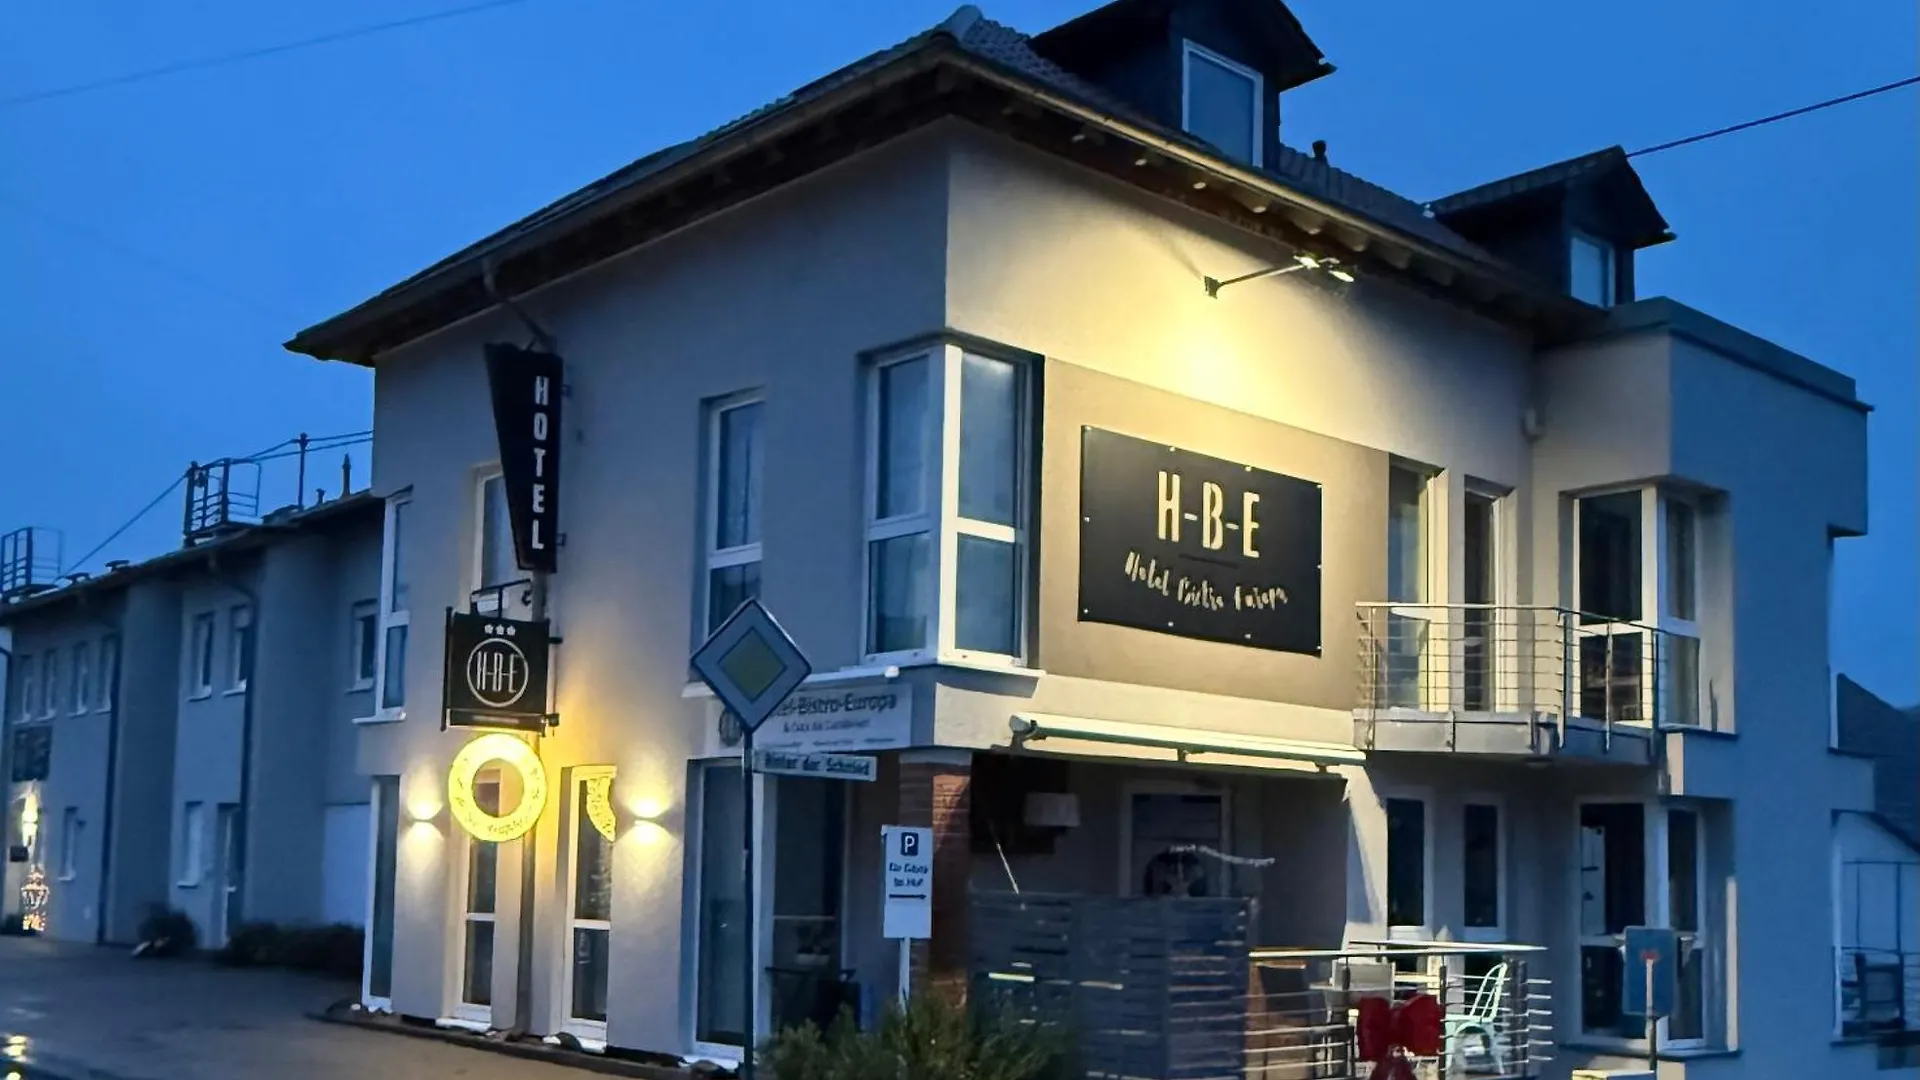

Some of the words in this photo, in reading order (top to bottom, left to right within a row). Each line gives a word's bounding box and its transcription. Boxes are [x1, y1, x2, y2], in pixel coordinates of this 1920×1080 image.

[532, 376, 549, 550] HOTEL
[1157, 471, 1260, 558] H-B-E
[1124, 552, 1169, 596] Hotel
[905, 835, 915, 853] P
